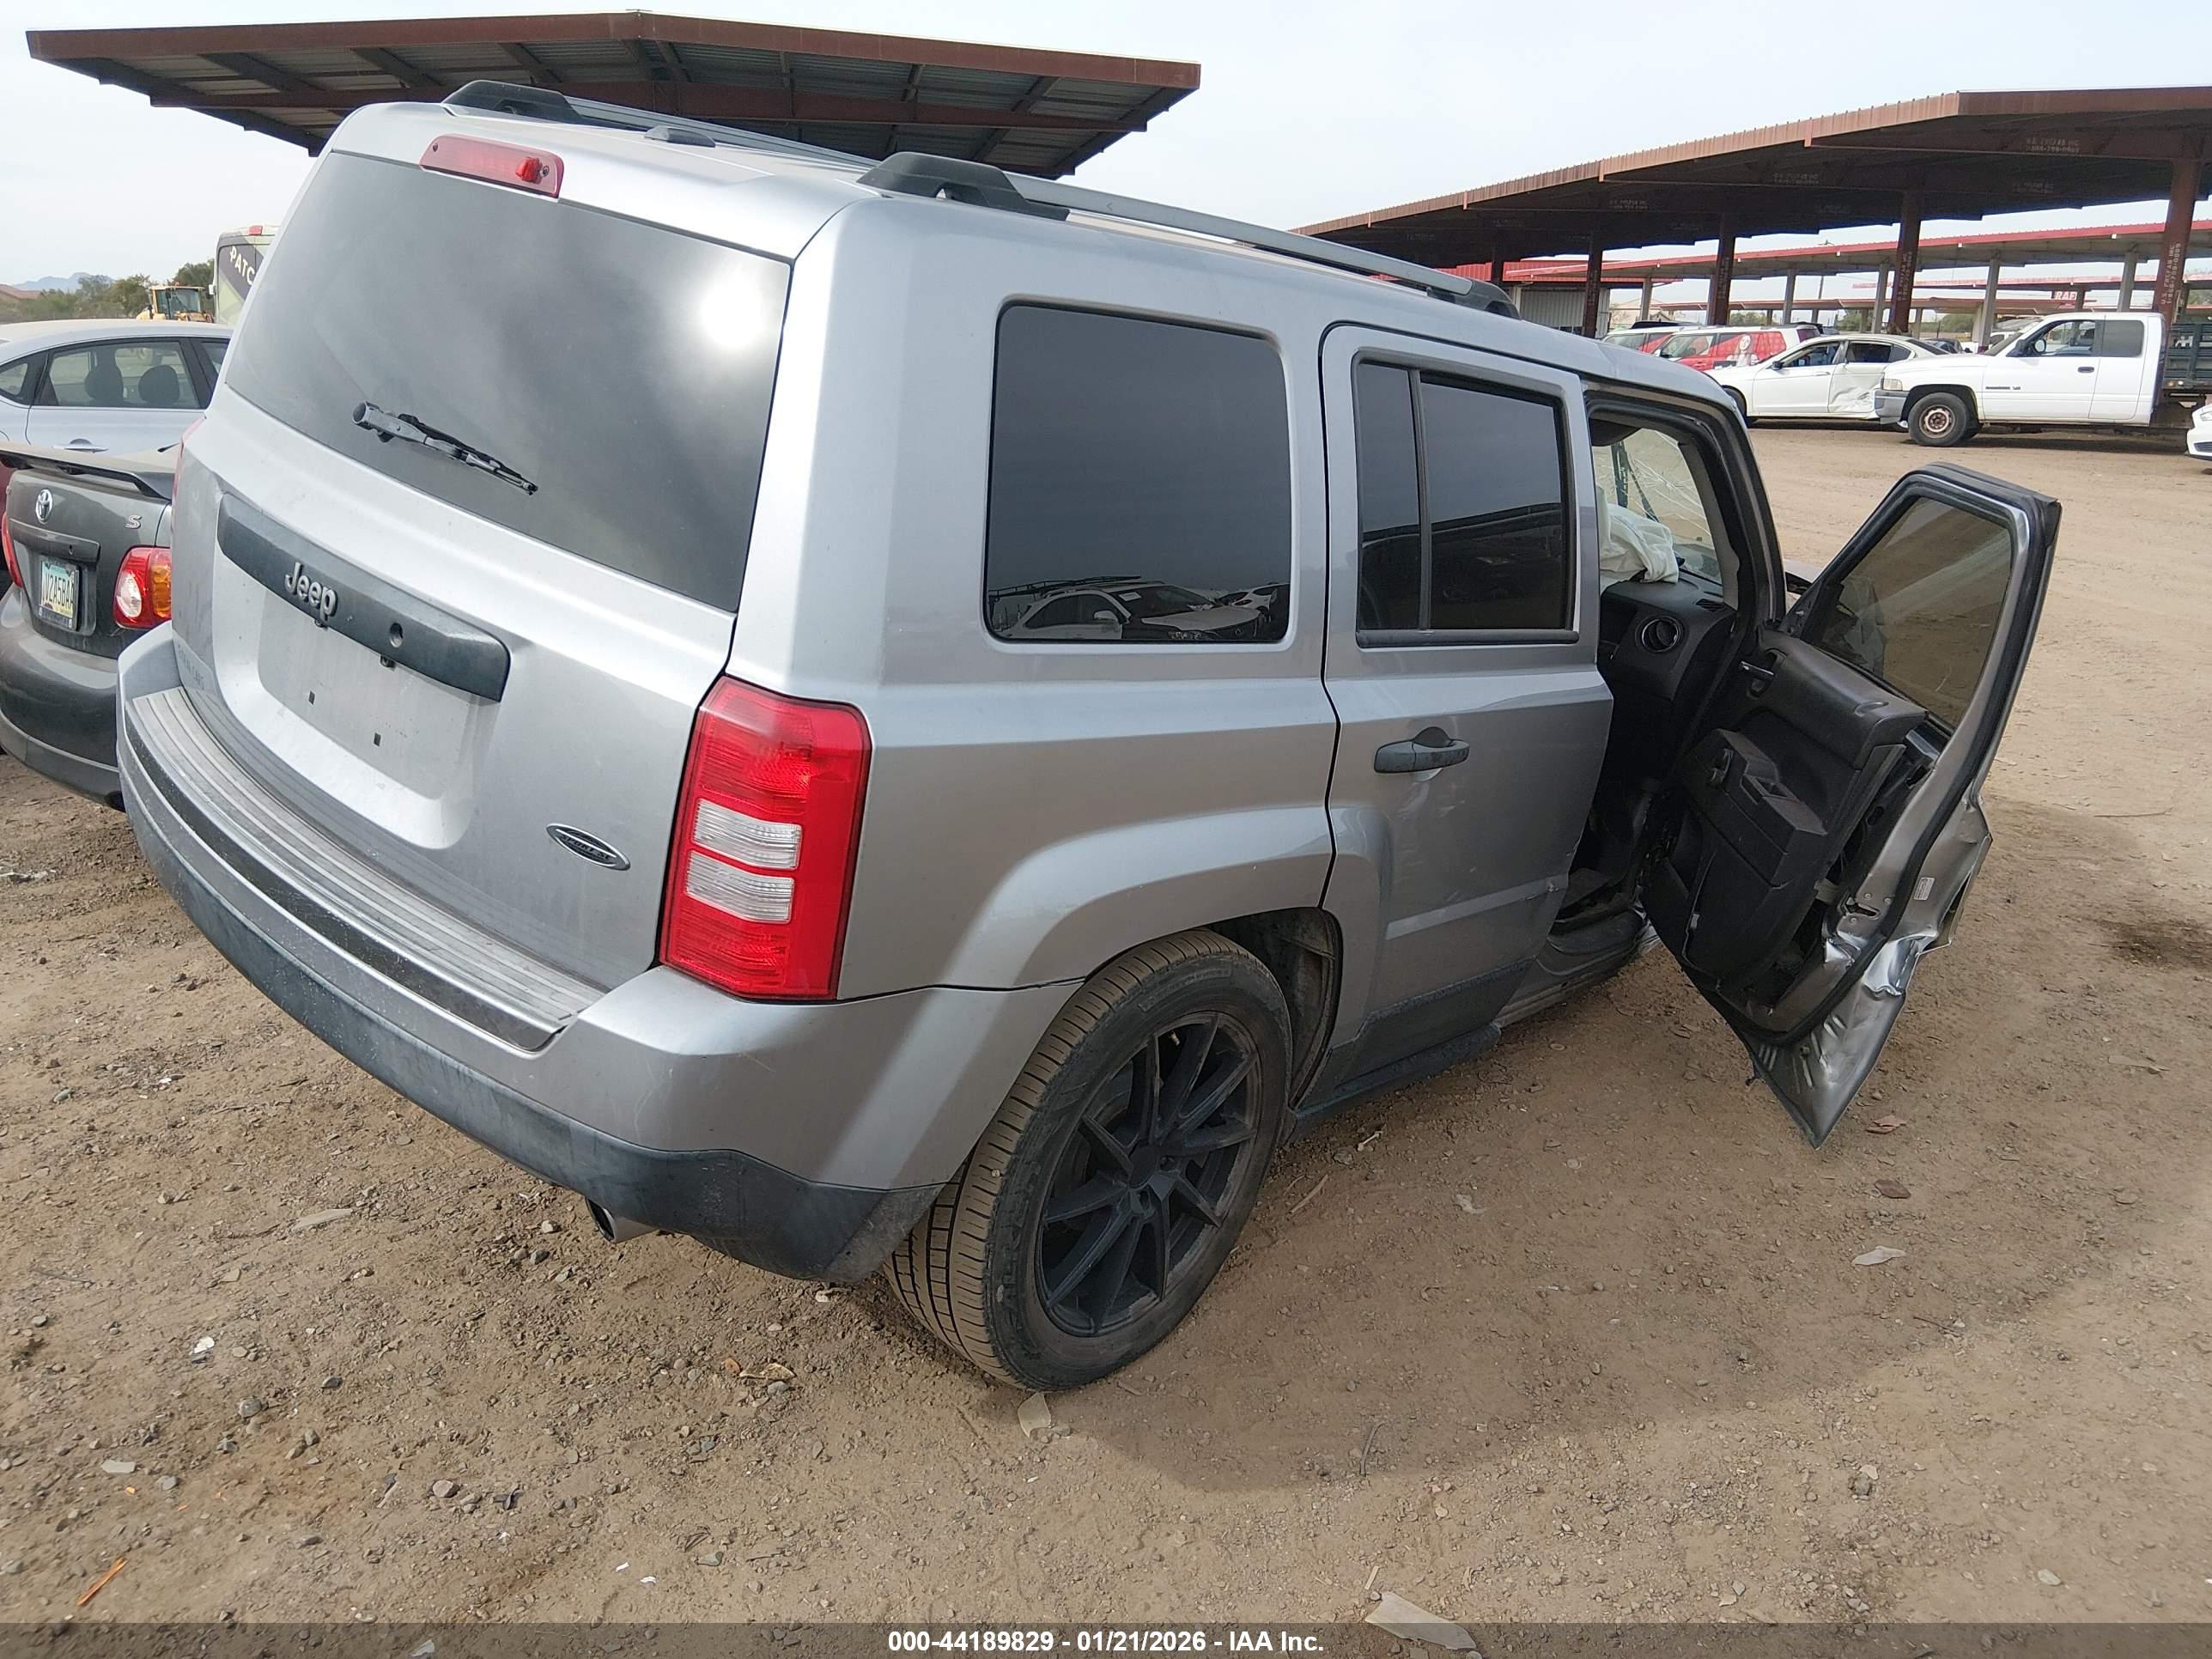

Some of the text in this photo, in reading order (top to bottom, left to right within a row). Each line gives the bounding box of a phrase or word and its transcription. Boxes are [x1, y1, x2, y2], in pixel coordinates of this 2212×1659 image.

[229, 246, 255, 285] PATC
[125, 515, 141, 528] S
[284, 562, 337, 625] Jeep
[562, 835, 595, 852] SPORT
